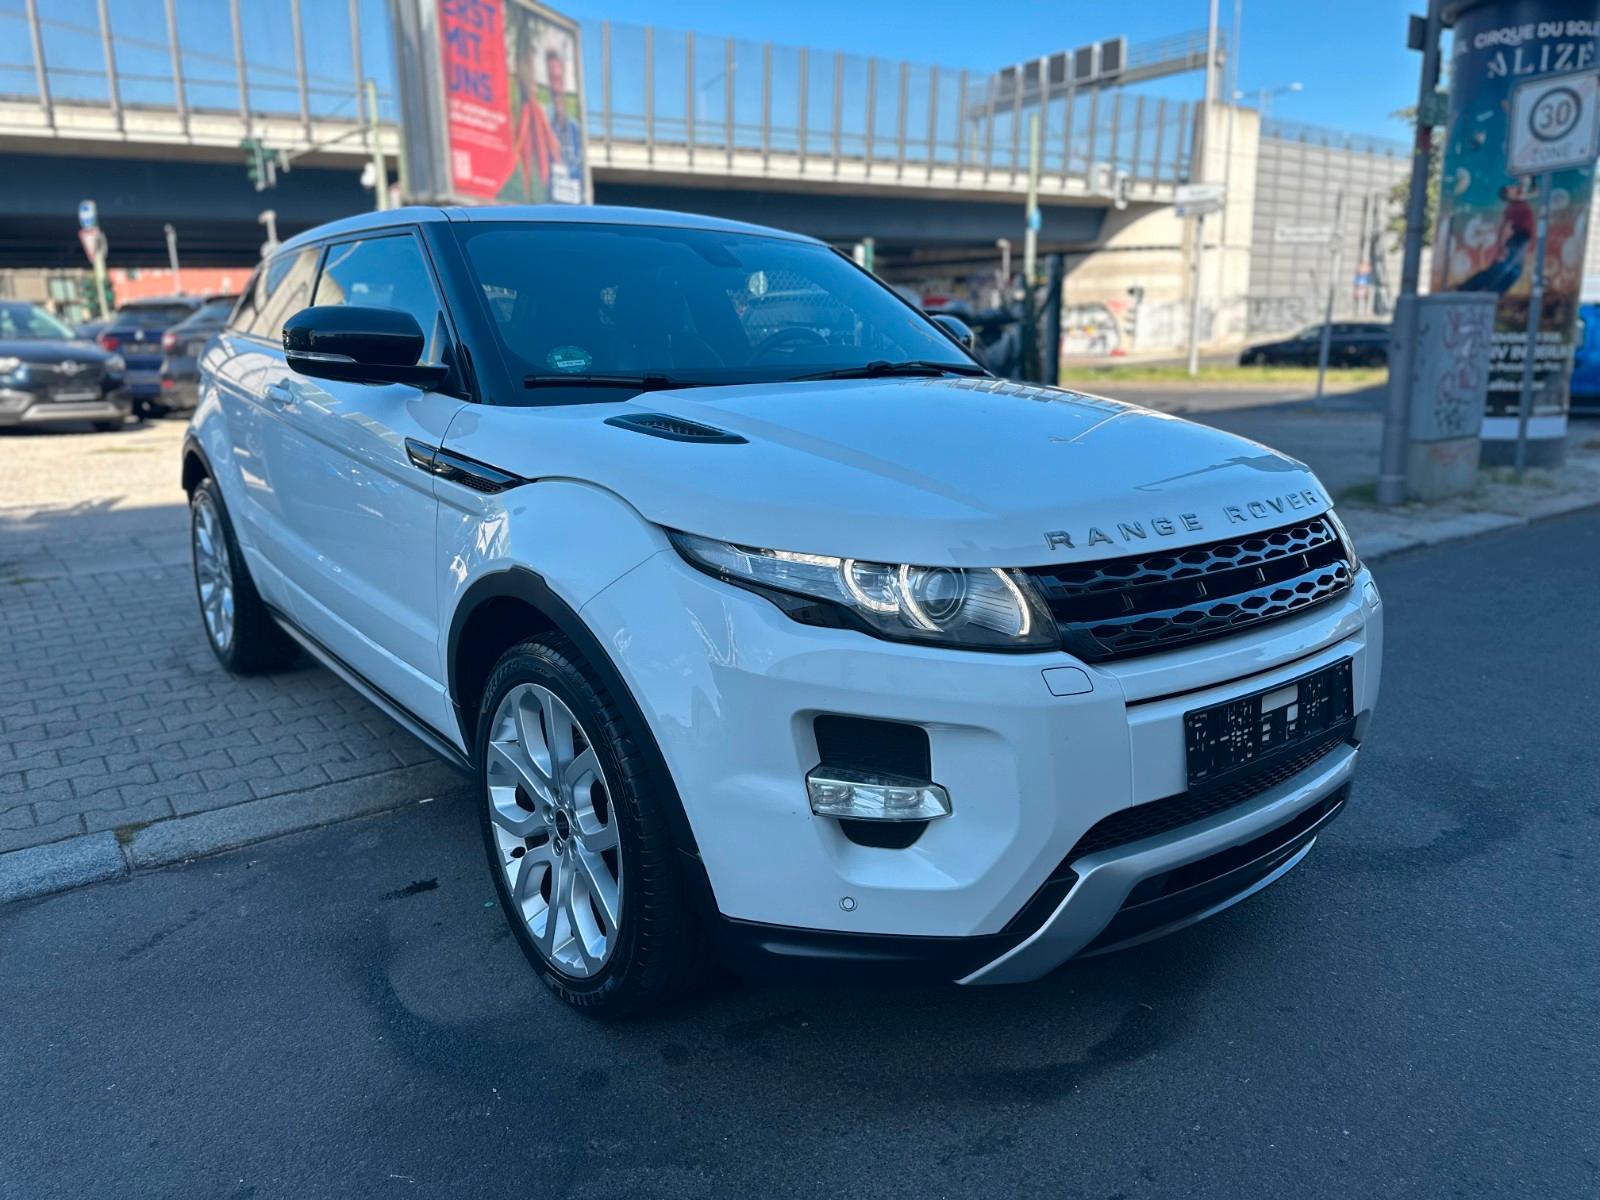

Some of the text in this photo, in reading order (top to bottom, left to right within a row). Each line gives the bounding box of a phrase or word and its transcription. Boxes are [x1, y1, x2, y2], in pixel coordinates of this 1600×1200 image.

[1474, 24, 1535, 48] CIRQUE
[1538, 21, 1563, 38] DU
[1539, 100, 1573, 130] 30
[1043, 488, 1318, 551] RANGE ROVER
